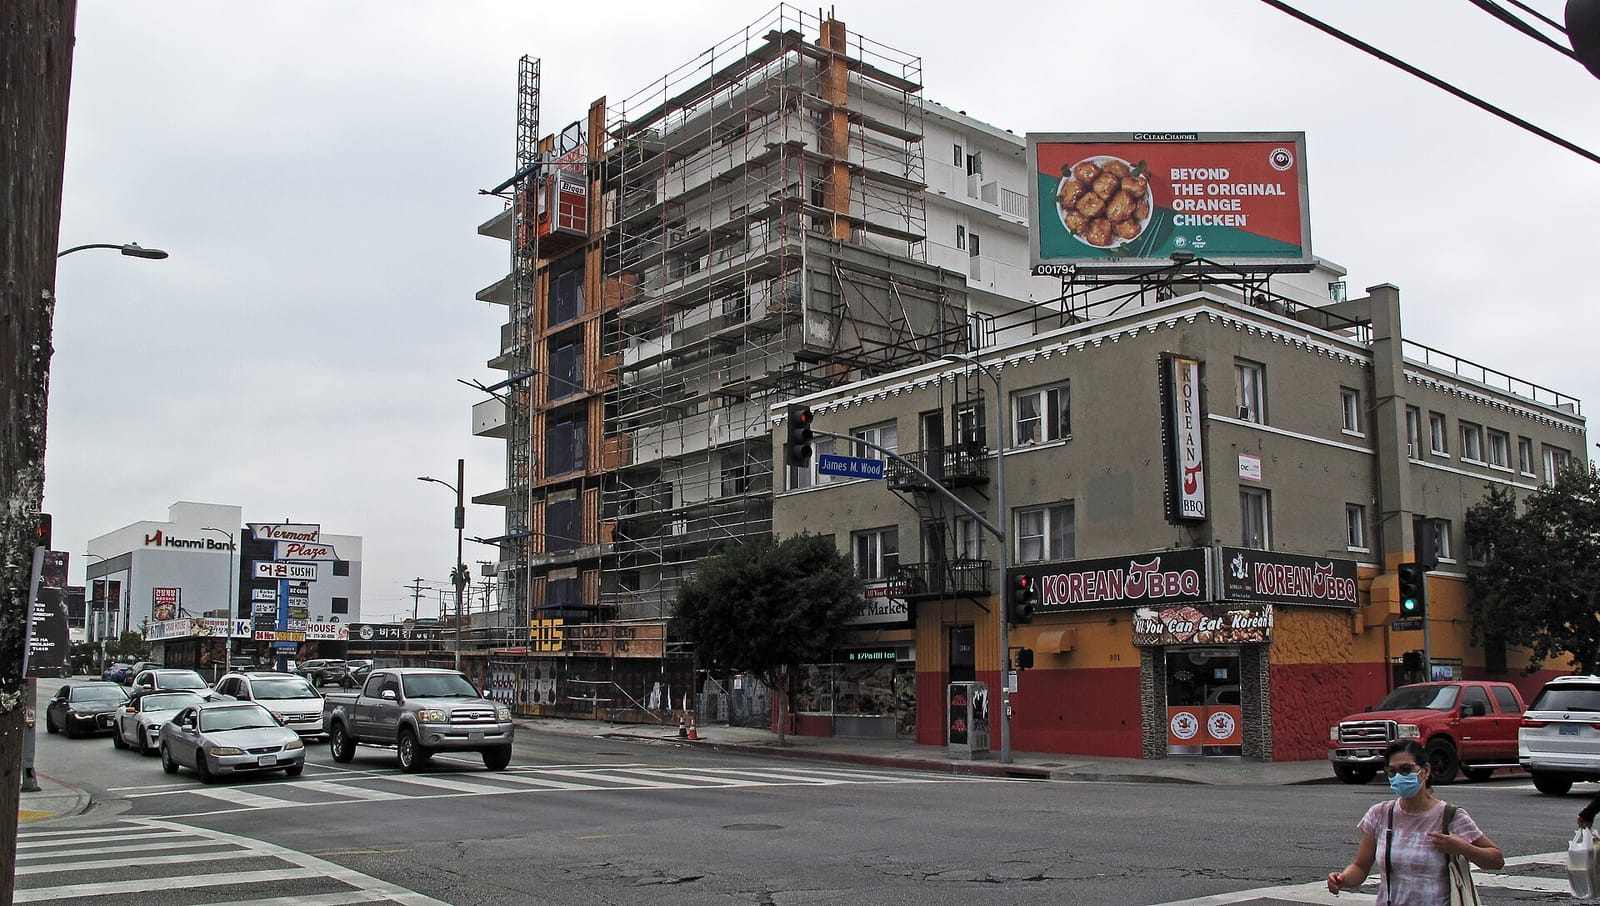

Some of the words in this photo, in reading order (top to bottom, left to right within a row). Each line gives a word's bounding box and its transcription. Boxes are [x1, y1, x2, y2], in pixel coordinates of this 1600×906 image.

[1170, 168, 1230, 181] BEYOND
[1171, 183, 1205, 196] THE
[1207, 183, 1286, 197] ORIGINAL
[1172, 199, 1242, 212] ORANGE
[1172, 214, 1247, 227] CHICKEN
[1037, 265, 1076, 275] 001794
[1182, 367, 1196, 462] KOREAN
[821, 459, 847, 472] James
[850, 461, 859, 473] M.
[861, 462, 880, 475] Wood
[1183, 499, 1204, 516] BBQ
[259, 524, 318, 542] Vermont
[165, 535, 205, 549] Hanmi
[206, 539, 237, 551] Bank
[285, 543, 328, 559] Plaza
[290, 566, 314, 577] SUSHI
[1041, 567, 1125, 606] KOREAN
[1148, 569, 1200, 599] BBQ
[1254, 562, 1313, 597] KOREAN
[1326, 575, 1357, 604] BBQ
[868, 599, 906, 617] Market
[307, 623, 336, 633] HOUSE
[1145, 619, 1163, 634] You
[1167, 618, 1193, 634] Can
[1198, 616, 1224, 632] Eat
[1231, 613, 1268, 629] Korean
